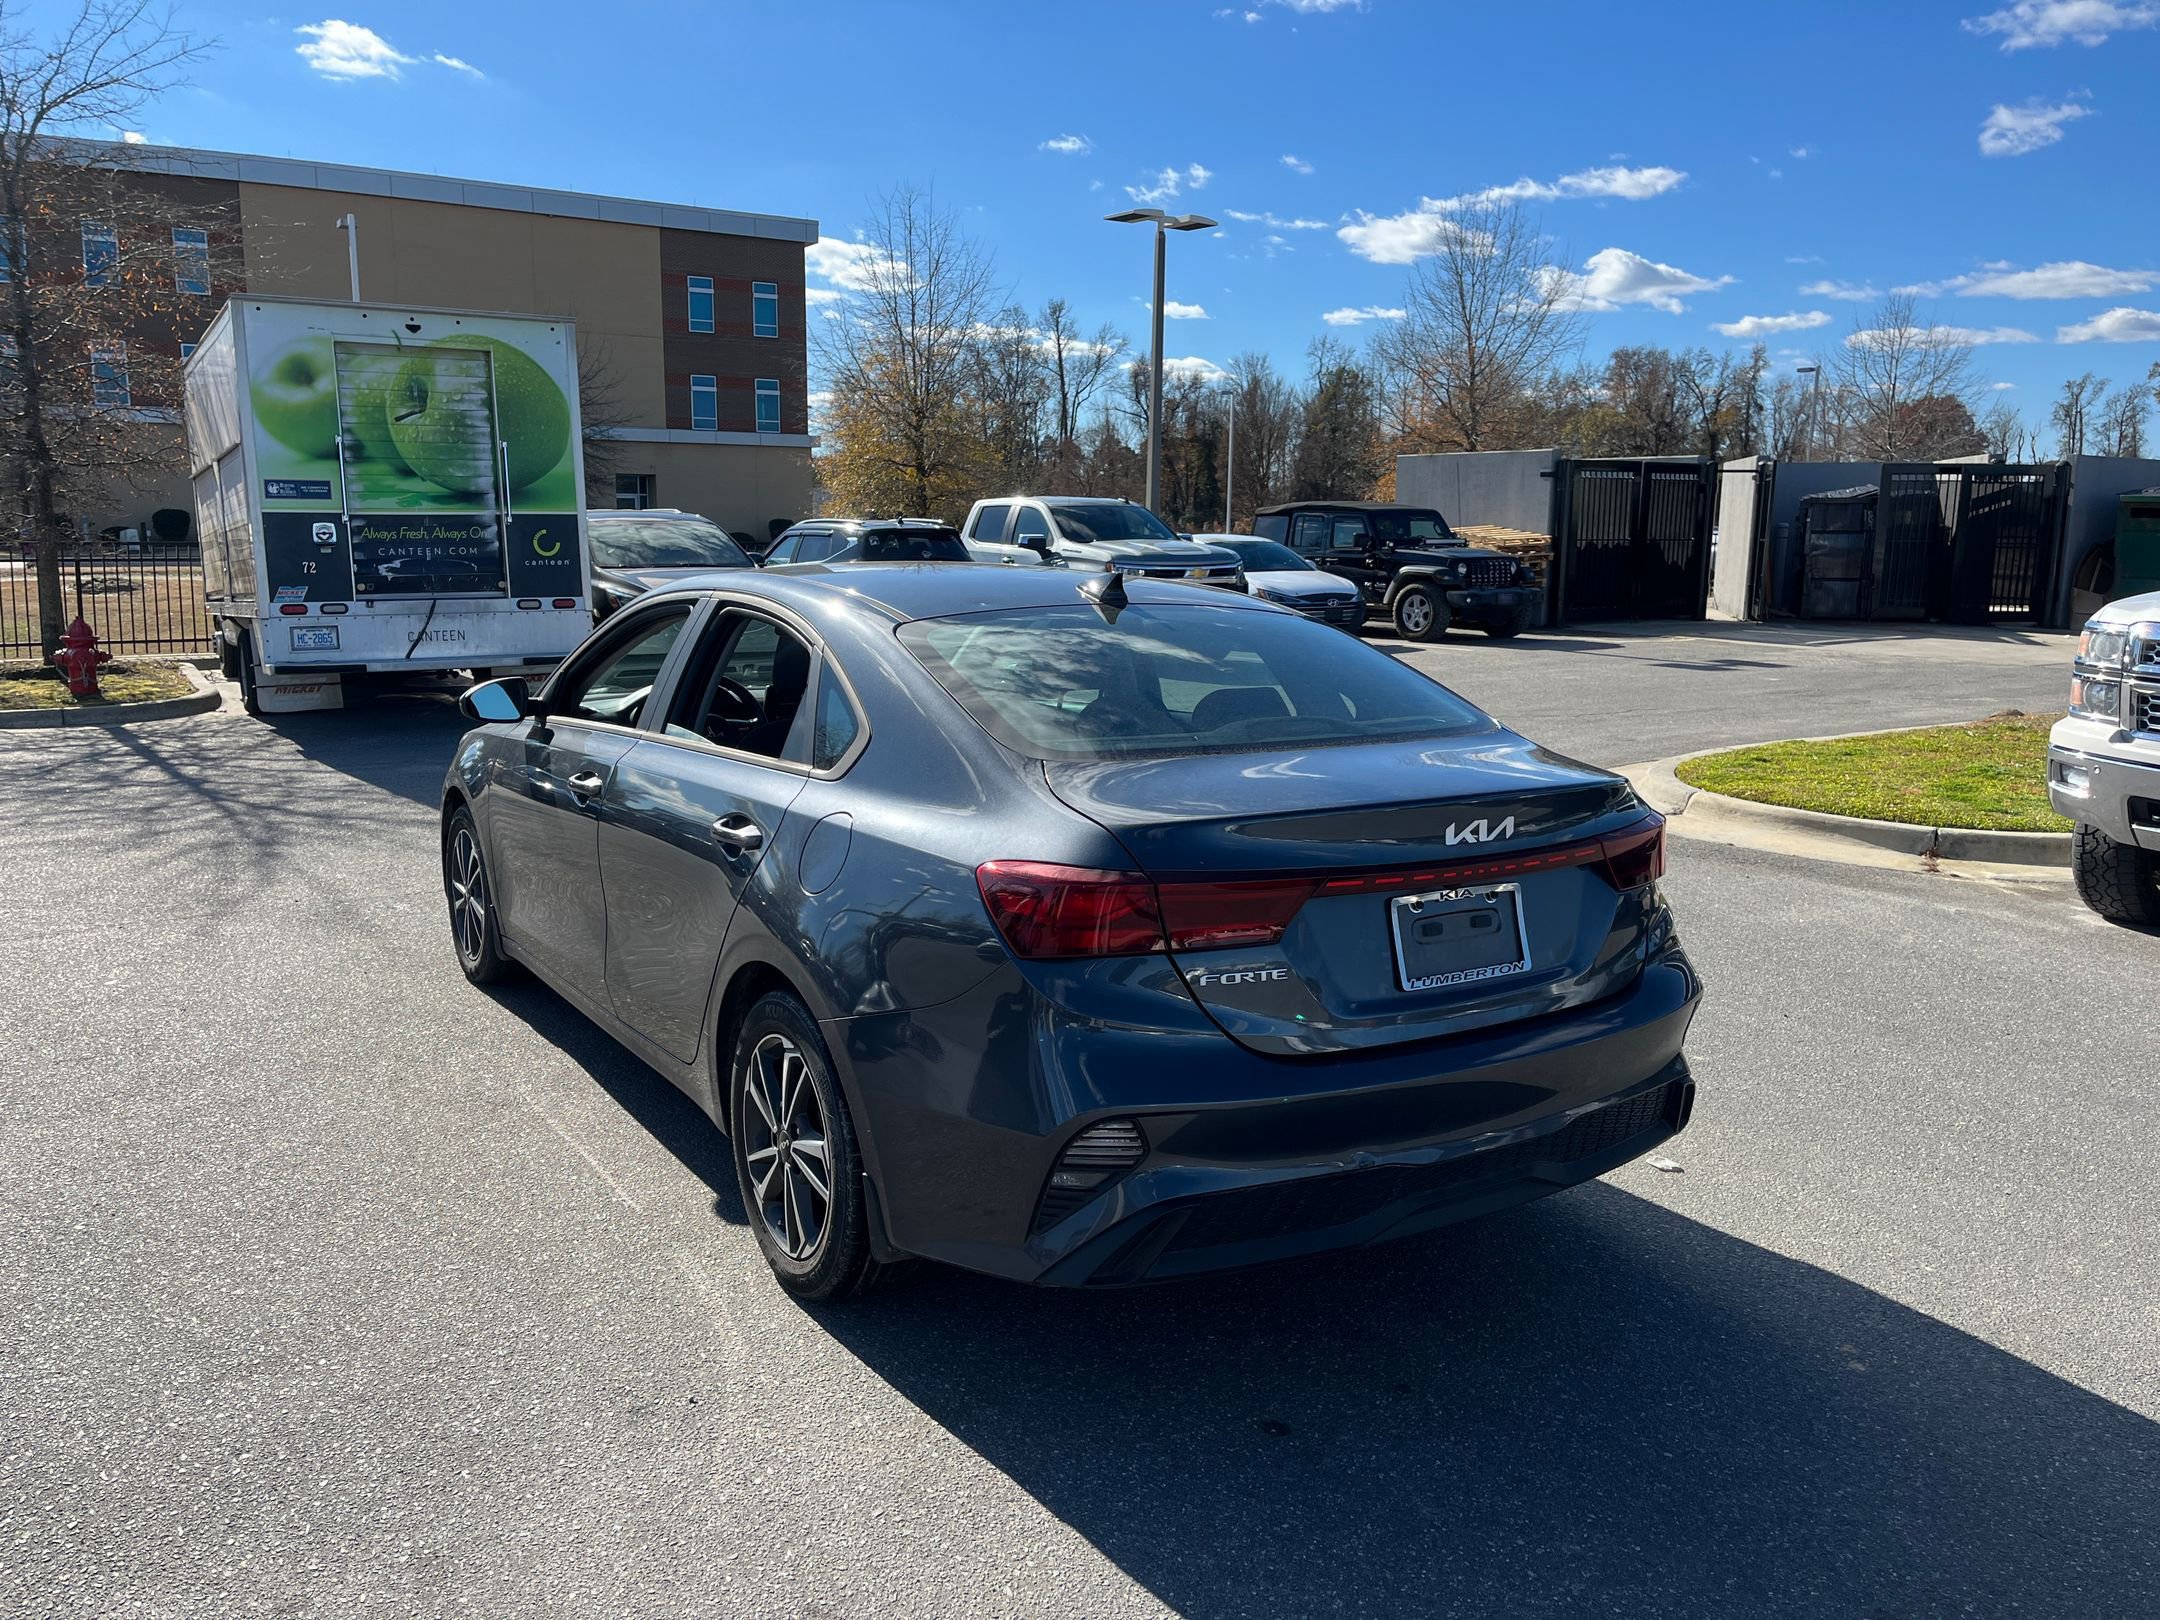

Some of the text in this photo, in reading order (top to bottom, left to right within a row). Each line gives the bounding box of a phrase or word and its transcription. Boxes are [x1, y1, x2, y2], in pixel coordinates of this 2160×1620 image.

[361, 526, 397, 541] Always
[432, 526, 467, 541] Always
[378, 546, 478, 557] CANTEEN.COM
[302, 561, 317, 574] 72
[297, 632, 334, 645] HC-2865
[1445, 815, 1515, 846] KIA
[1439, 887, 1475, 901] KIA
[1199, 968, 1289, 987] FORTE
[1410, 961, 1526, 990] LUMBERTON
